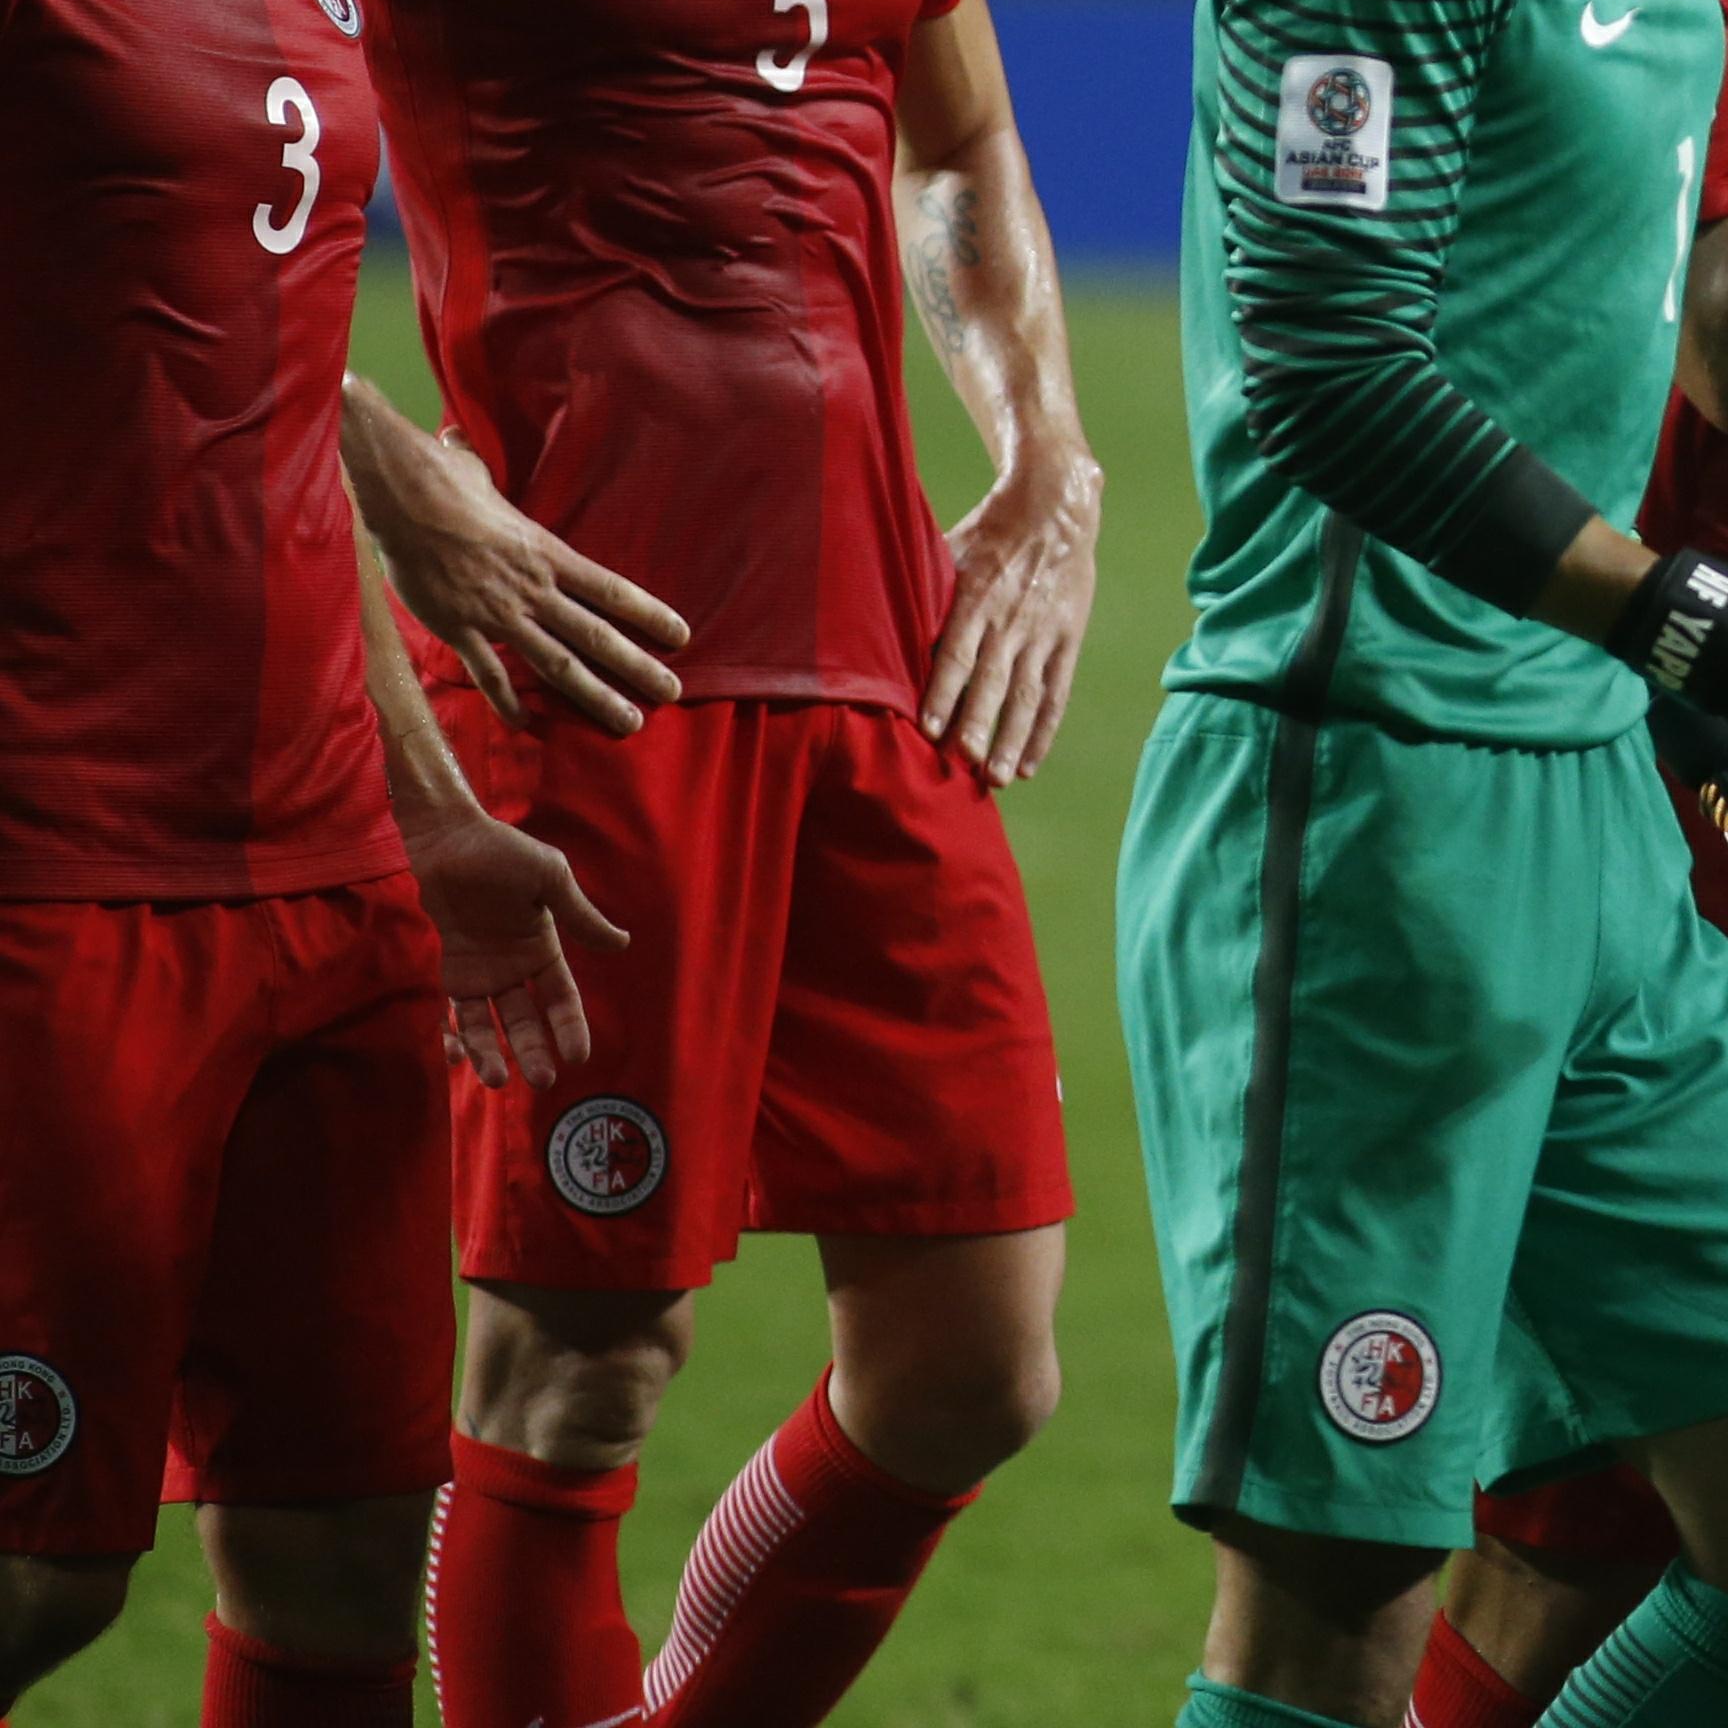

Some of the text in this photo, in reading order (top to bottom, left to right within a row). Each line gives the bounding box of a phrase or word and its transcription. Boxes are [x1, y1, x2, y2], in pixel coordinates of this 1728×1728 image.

[252, 76, 321, 256] 3
[1286, 150, 1343, 165] ASIAN
[1664, 135, 1696, 322] 1
[0, 1360, 55, 1384] ONG KONG
